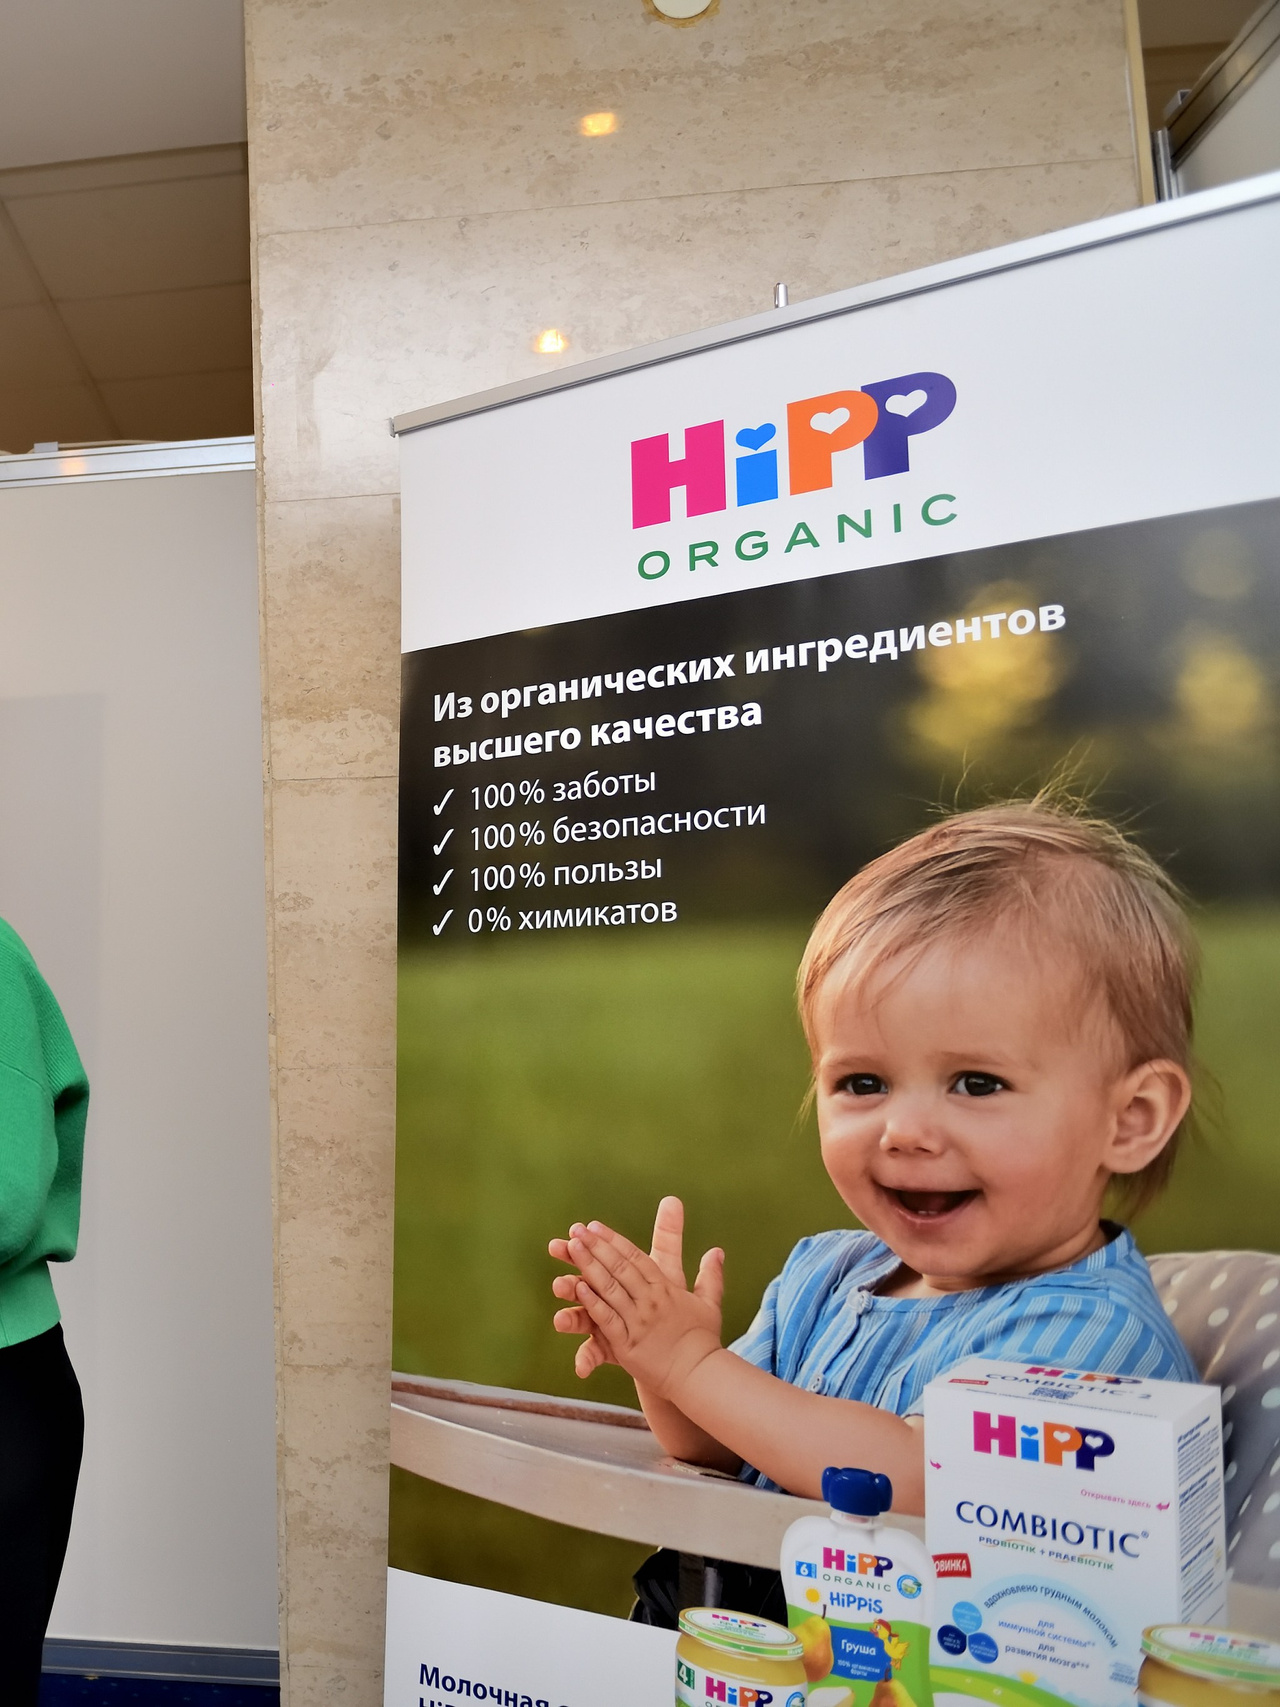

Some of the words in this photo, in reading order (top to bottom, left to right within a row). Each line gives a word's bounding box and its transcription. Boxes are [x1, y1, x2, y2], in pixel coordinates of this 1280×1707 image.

[631, 371, 957, 529] HiPP
[637, 493, 958, 580] ORGANIC
[433, 692, 473, 721] Из
[480, 653, 735, 719] органических
[745, 602, 1066, 671] ингредиентов
[433, 724, 581, 768] высшего
[590, 699, 763, 747] качества
[553, 771, 657, 804] заботы
[553, 803, 766, 845] безопасности
[553, 858, 662, 887] пользы
[518, 902, 678, 931] химикатов
[1025, 1366, 1143, 1385] HiPP
[973, 1410, 1115, 1472] HiPP
[1080, 1488, 1125, 1504] Открывать
[1128, 1498, 1152, 1509] здесь
[823, 1547, 893, 1578] HiPP
[978, 1536, 1036, 1554] PROBIOTIK
[1049, 1551, 1114, 1571] PRAEBIOTIK
[799, 1564, 809, 1577] 6
[934, 1560, 967, 1573] ОВИНКА
[822, 1573, 892, 1592] ORGANIC
[829, 1592, 883, 1614] HiPPiS
[711, 1613, 767, 1628] HiPP
[984, 1584, 1038, 1609] вдохновлено
[1040, 1586, 1082, 1610] грудным
[1082, 1607, 1119, 1649] молоком
[998, 1620, 1046, 1637] иммунной
[1037, 1620, 1055, 1629] для
[841, 1639, 876, 1656] Груша
[1005, 1645, 1047, 1661] развития
[1037, 1643, 1055, 1653] для
[679, 1662, 688, 1683] 4
[705, 1676, 773, 1707] HiPP
